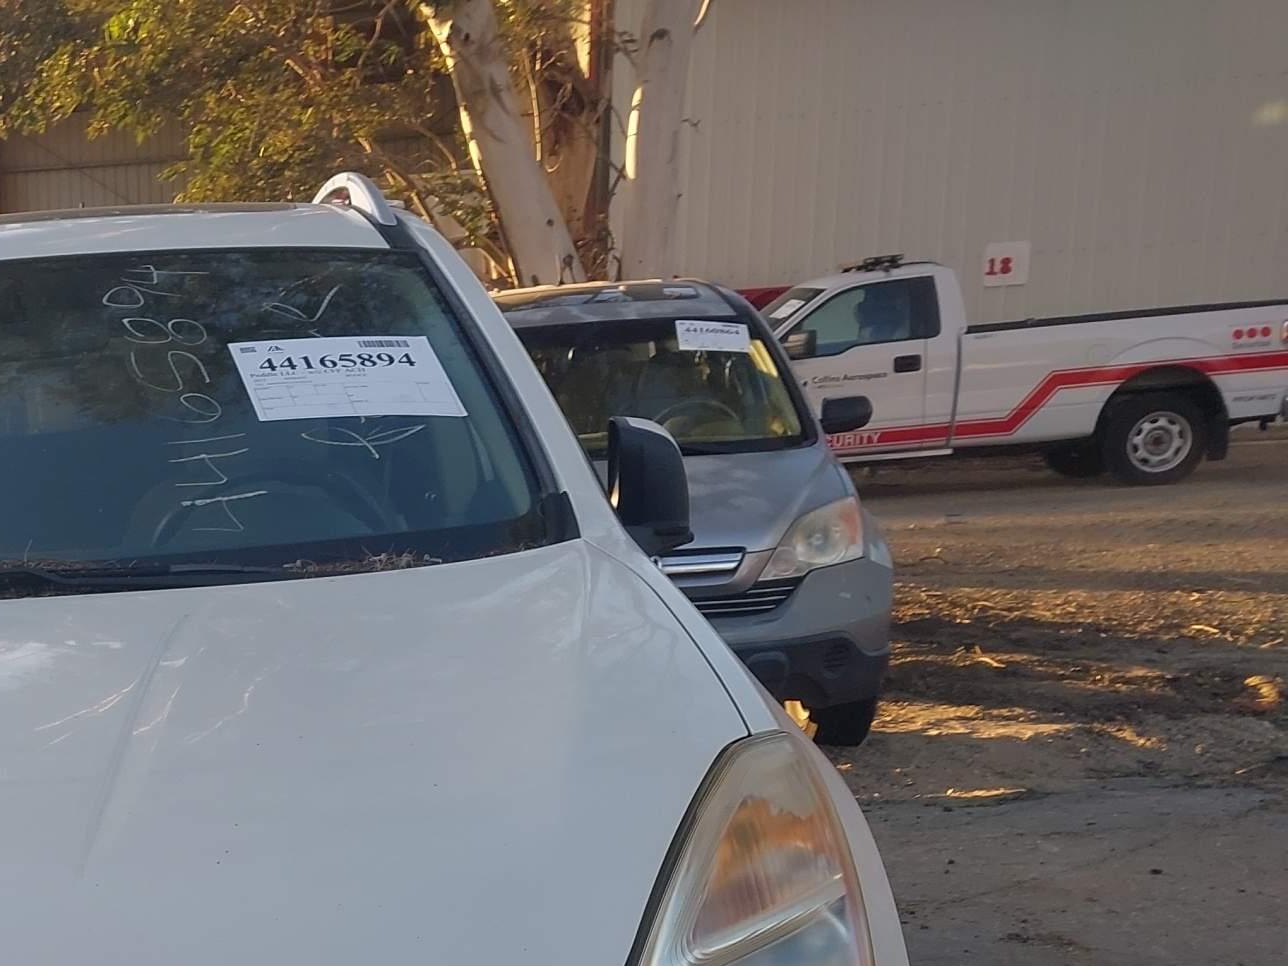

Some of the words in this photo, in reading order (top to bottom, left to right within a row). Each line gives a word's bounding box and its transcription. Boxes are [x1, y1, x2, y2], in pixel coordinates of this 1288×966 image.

[984, 256, 1013, 276] 18
[259, 351, 417, 372] 44165894
[824, 431, 881, 449] CURITY
